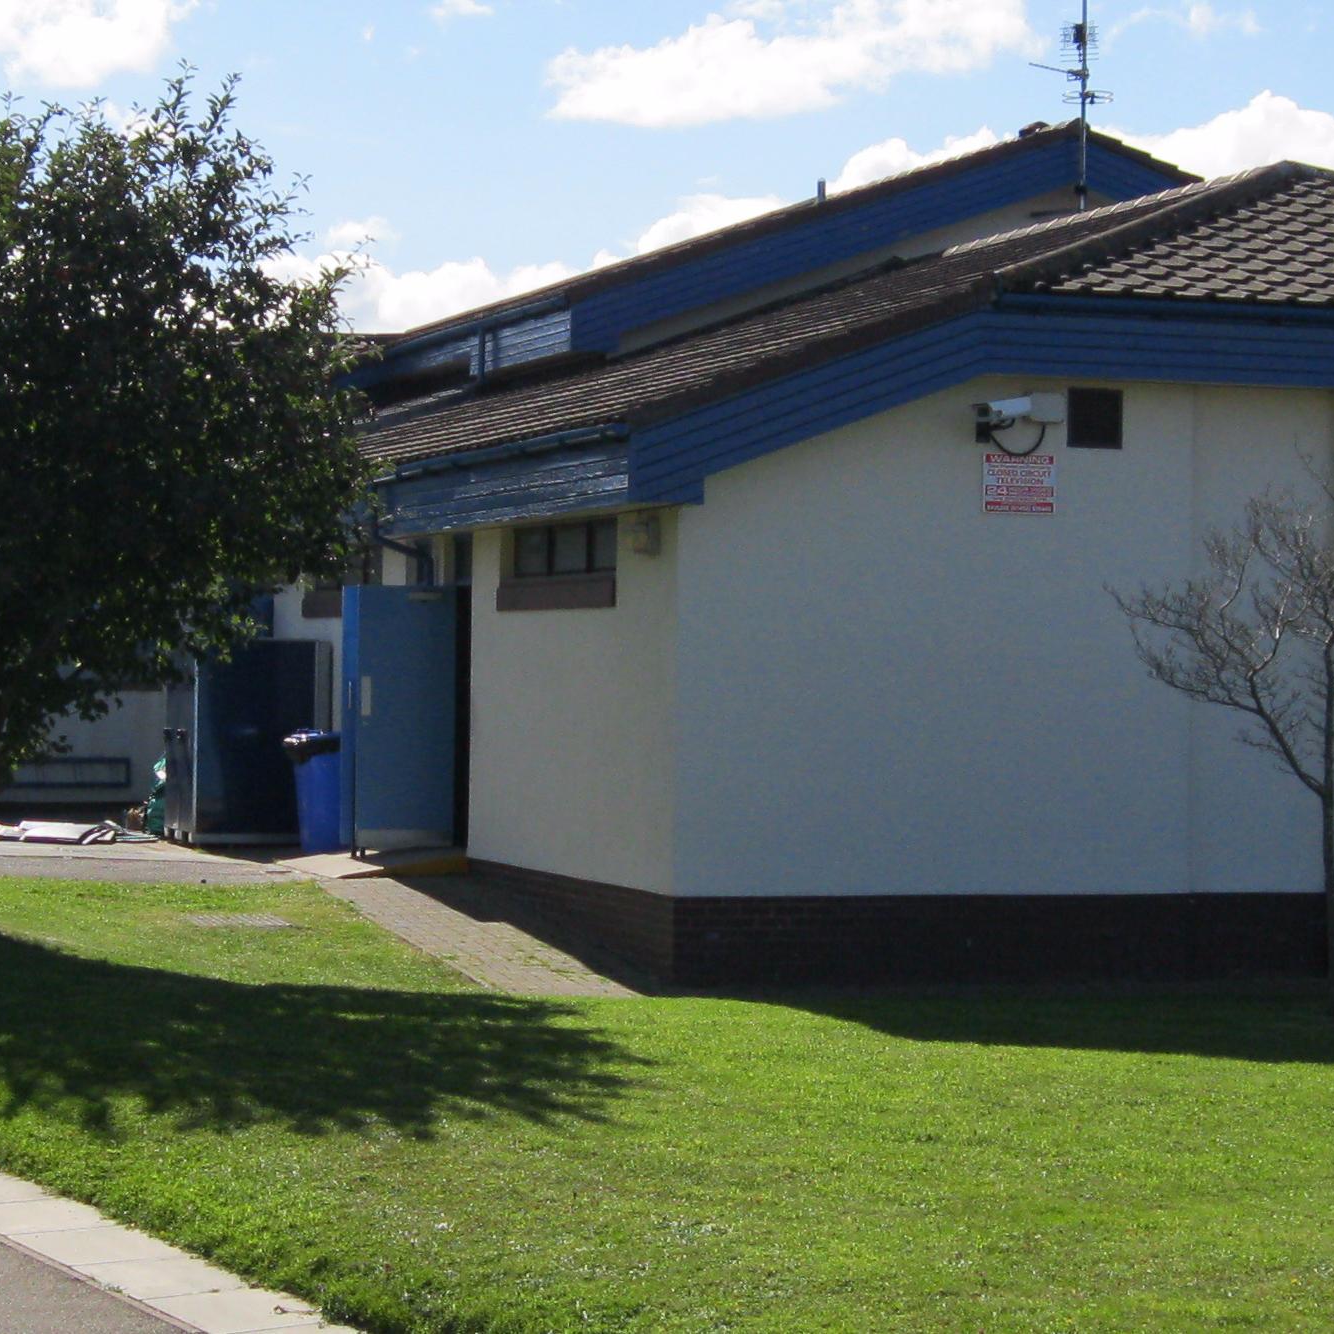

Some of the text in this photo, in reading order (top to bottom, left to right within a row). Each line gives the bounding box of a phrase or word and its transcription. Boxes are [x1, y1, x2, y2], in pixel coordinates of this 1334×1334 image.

[990, 455, 1050, 464] WARNING
[987, 469, 1018, 477] CLOSED
[996, 477, 1044, 485] TELEVISION
